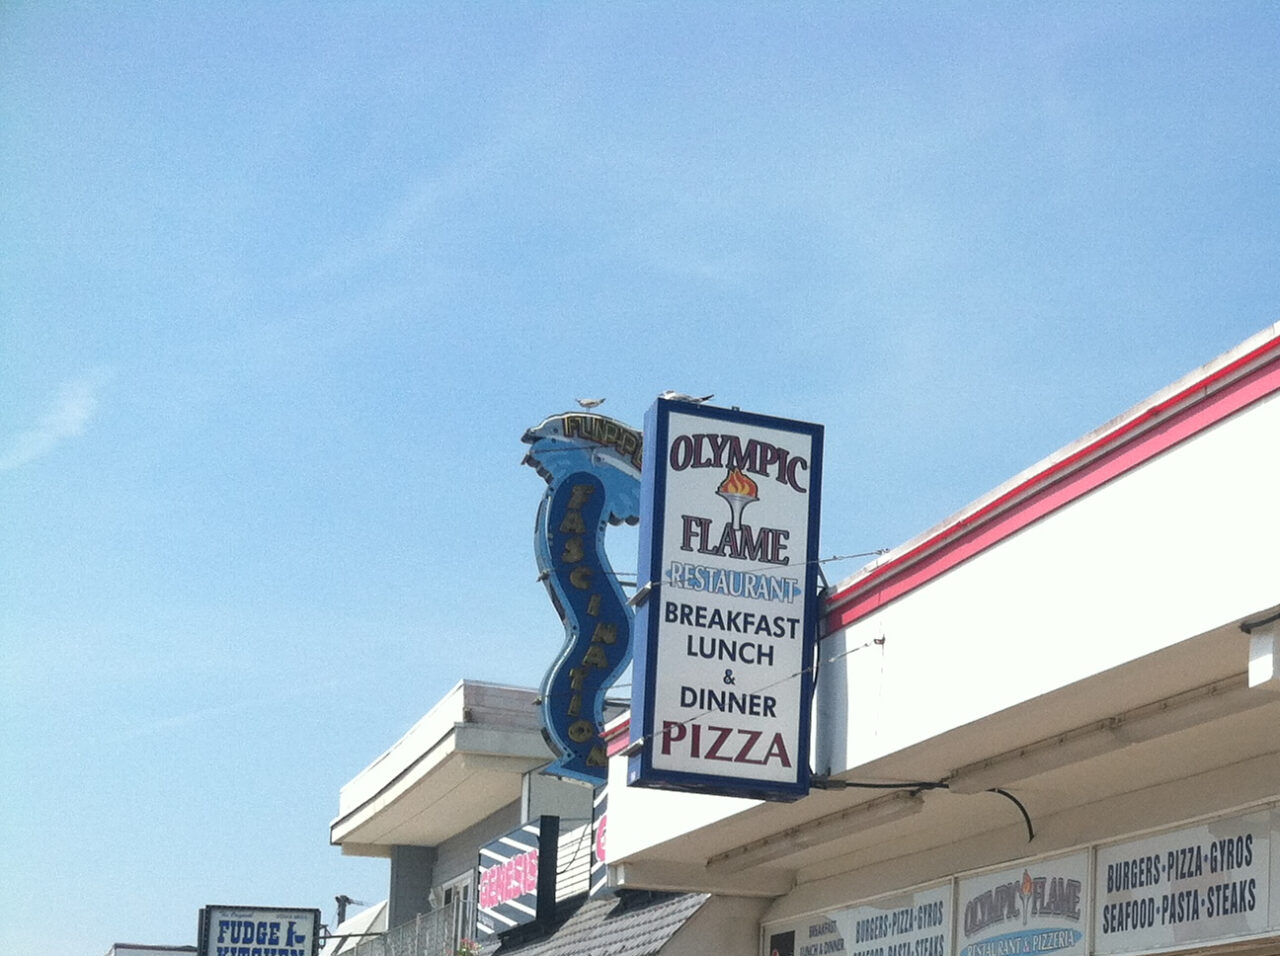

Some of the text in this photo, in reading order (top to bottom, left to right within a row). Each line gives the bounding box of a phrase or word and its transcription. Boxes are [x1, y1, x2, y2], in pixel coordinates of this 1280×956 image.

[670, 434, 808, 493] OLYMPIC
[681, 514, 790, 565] FLAME
[670, 561, 798, 604] RESTAURANT
[664, 601, 800, 640] BREAKFAST
[686, 634, 775, 666] LUNCH
[722, 668, 736, 686] &
[680, 686, 777, 718] DINNER
[661, 720, 792, 768] PIZZA
[1107, 833, 1254, 894] BURGERS PIZZA GYROS
[855, 900, 944, 945] BURGERS PIZZA GYROS
[964, 876, 1082, 940] OLYMPIC FLAME
[1103, 878, 1257, 935] SEAFOOD PASTA STEAKS
[217, 919, 281, 946] FUDGE
[1032, 929, 1076, 951] PIZZERIA
